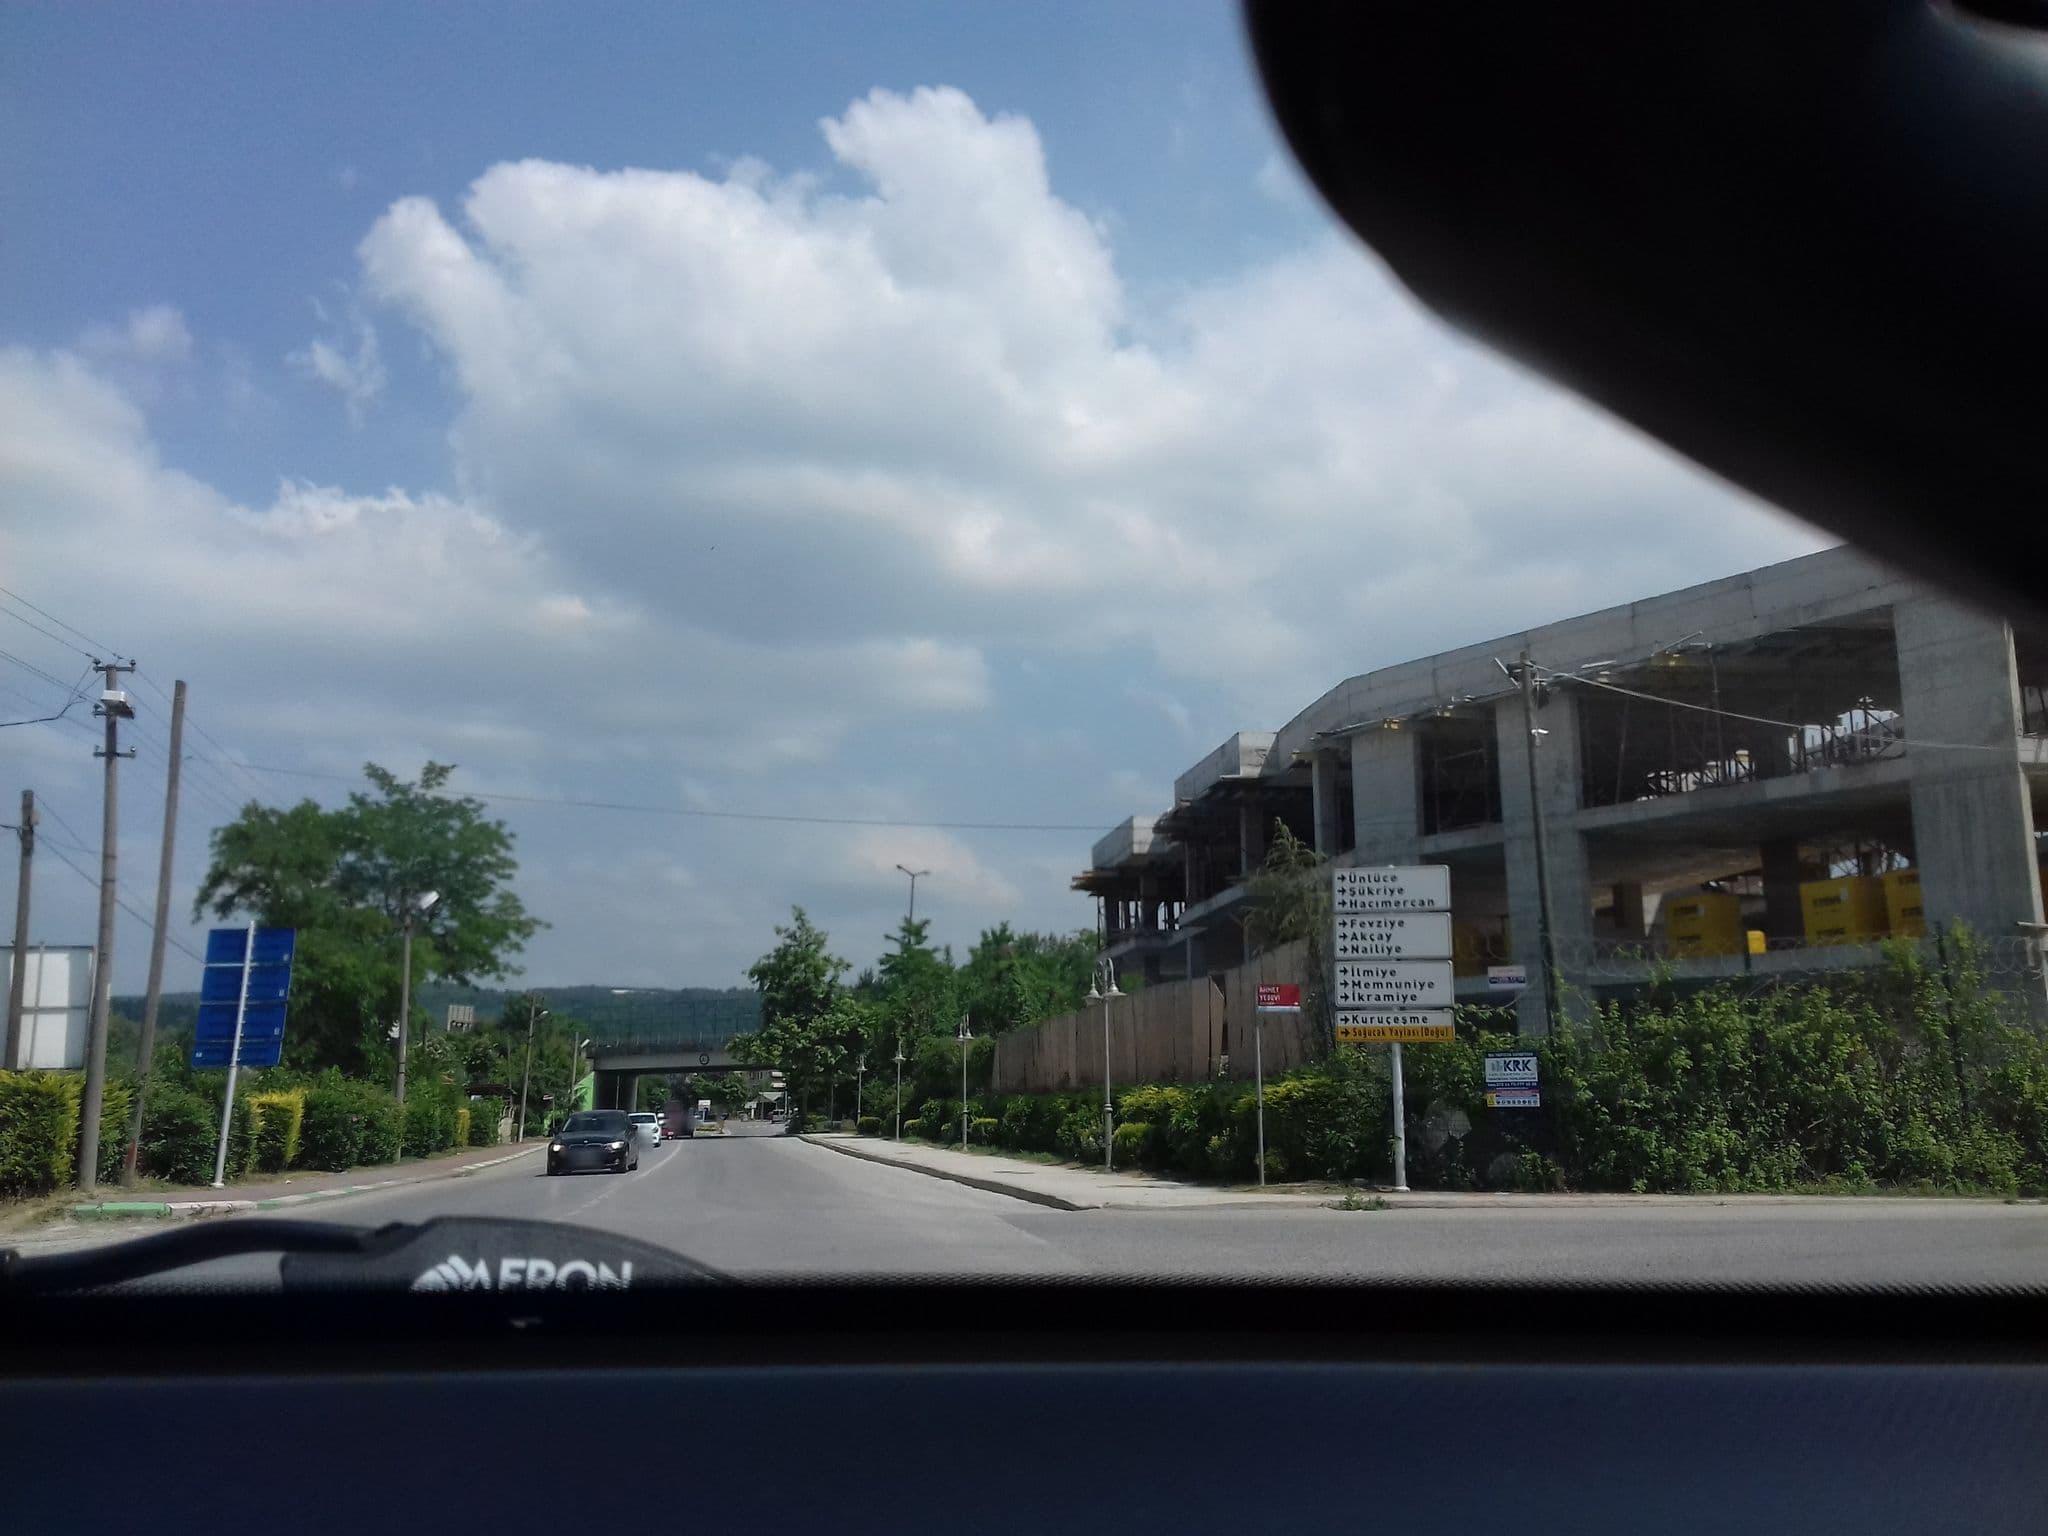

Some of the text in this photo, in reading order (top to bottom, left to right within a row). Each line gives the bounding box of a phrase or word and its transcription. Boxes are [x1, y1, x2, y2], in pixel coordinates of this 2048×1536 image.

[1349, 872, 1398, 884] Ünlüce
[1349, 886, 1404, 898] Şükriye
[1349, 898, 1435, 909] Hacımercan
[1350, 918, 1405, 930] Fevziye
[1350, 931, 1393, 943] Akçay
[1350, 943, 1402, 955] Nailiye
[1351, 966, 1398, 979] İlmiye
[1351, 979, 1435, 991] Memnuniye
[1352, 990, 1418, 1003] İkramiye
[1352, 1014, 1428, 1025] Kuruçeşme
[1503, 1059, 1532, 1072] KRK
